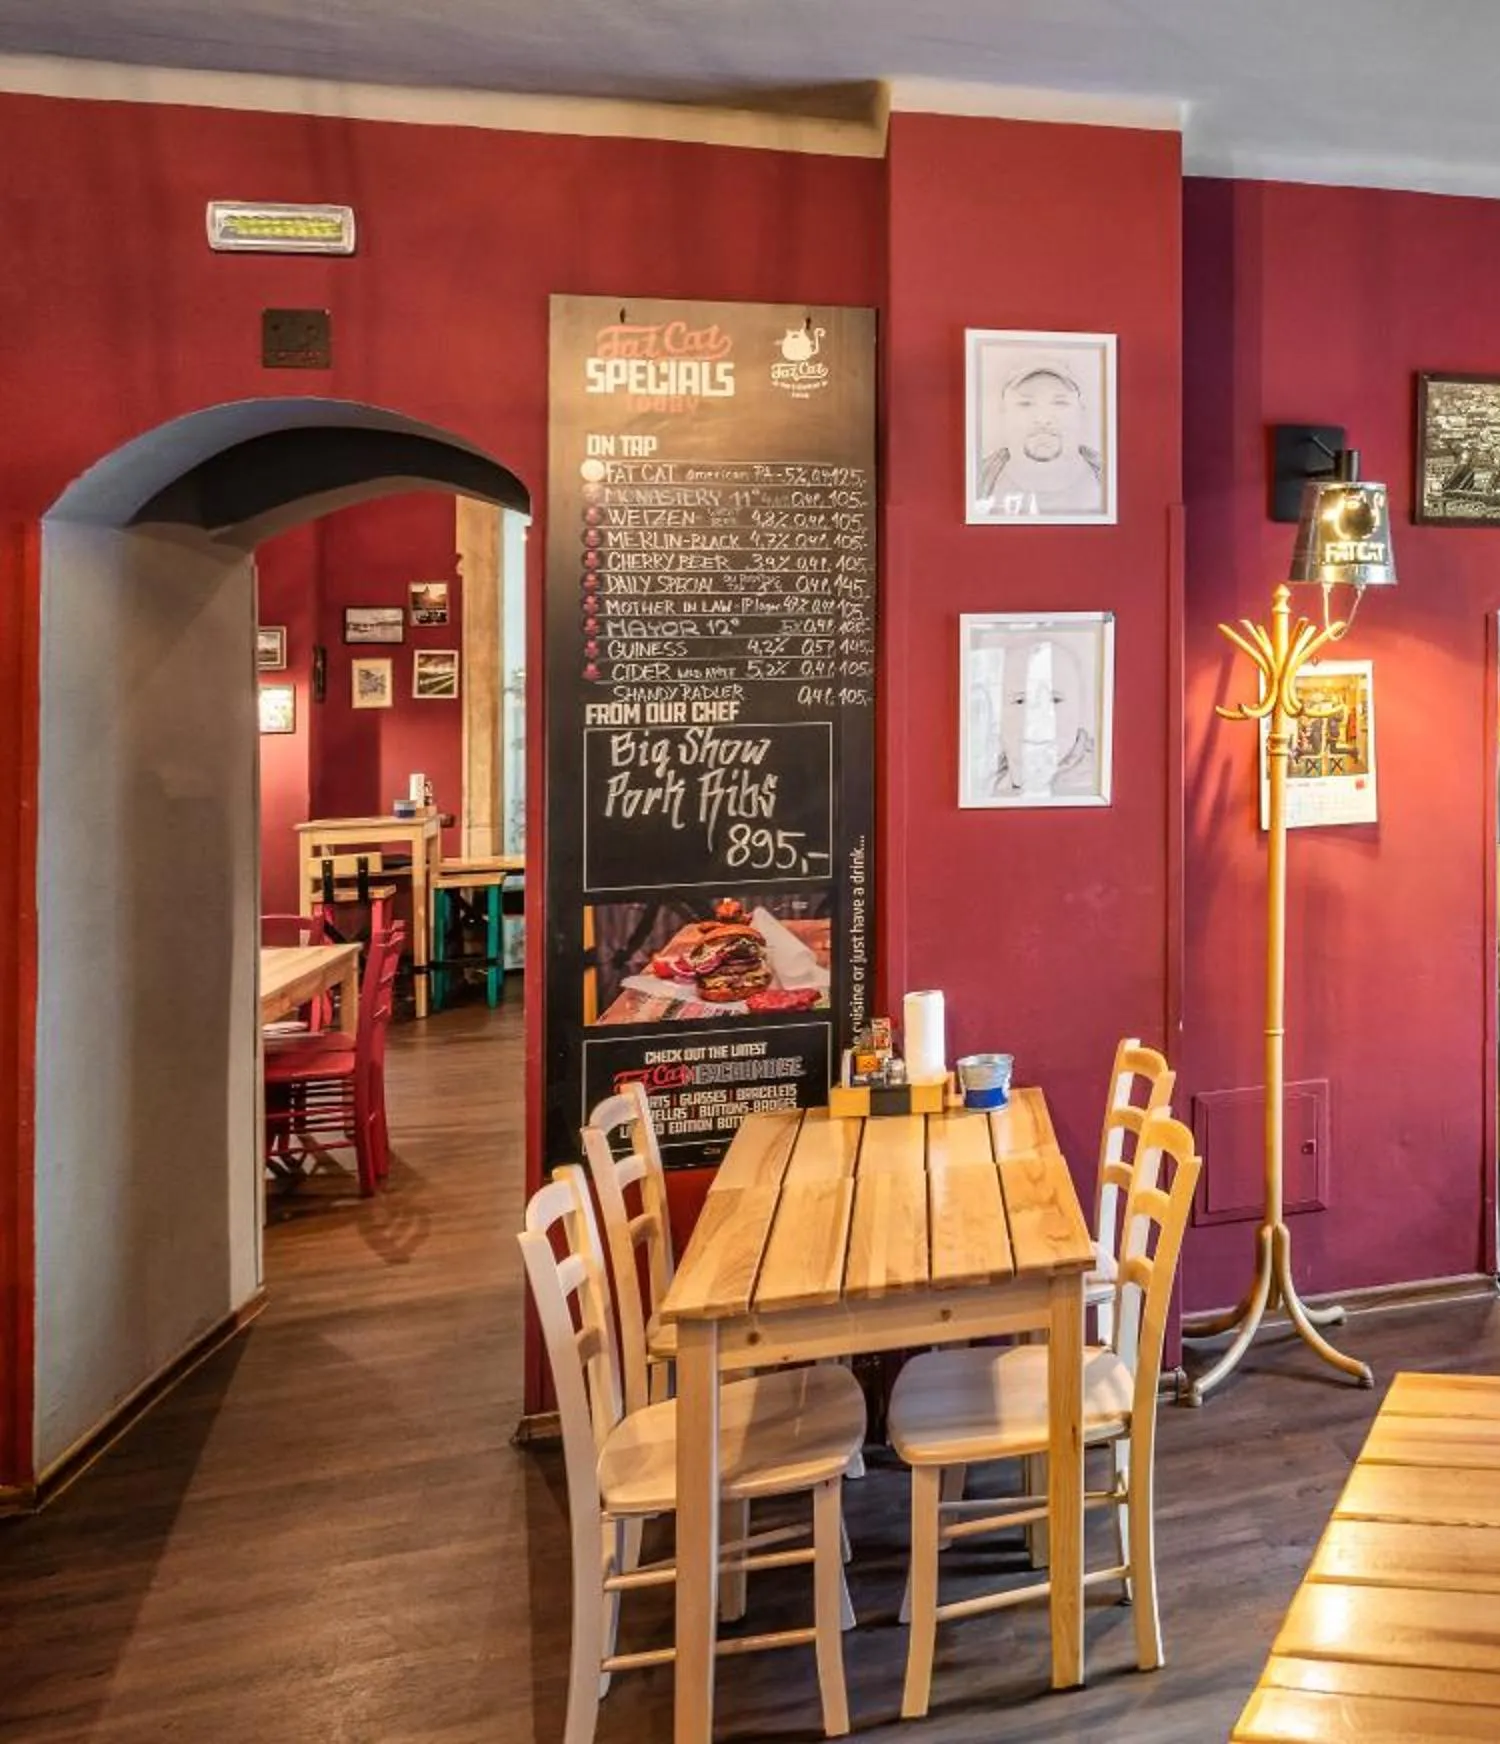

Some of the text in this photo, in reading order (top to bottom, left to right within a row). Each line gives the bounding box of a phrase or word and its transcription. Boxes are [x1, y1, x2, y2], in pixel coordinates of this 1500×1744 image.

[585, 359, 736, 397] SPECIALS
[587, 435, 657, 457] ON TAP
[606, 463, 640, 484] FAT
[642, 463, 677, 484] CAT
[607, 551, 675, 572] CHERRY
[607, 573, 651, 594] DAILY
[658, 575, 713, 593] SPECIAL
[605, 599, 676, 617] MOTHER
[682, 601, 697, 613] IN
[701, 599, 733, 613] LAW
[606, 618, 701, 637] MAYOR
[607, 639, 688, 660] GUINESS
[611, 662, 672, 683] CIDER
[613, 684, 679, 703] SHANDY
[585, 700, 740, 725] FROM OUR CHEF
[611, 726, 772, 778] Big Show
[604, 770, 687, 830] Pork
[849, 899, 865, 932] have
[849, 935, 868, 963] just
[853, 965, 865, 981] or
[645, 1049, 682, 1065] CHECK
[683, 1047, 706, 1062] OUT
[708, 1045, 729, 1059] THE
